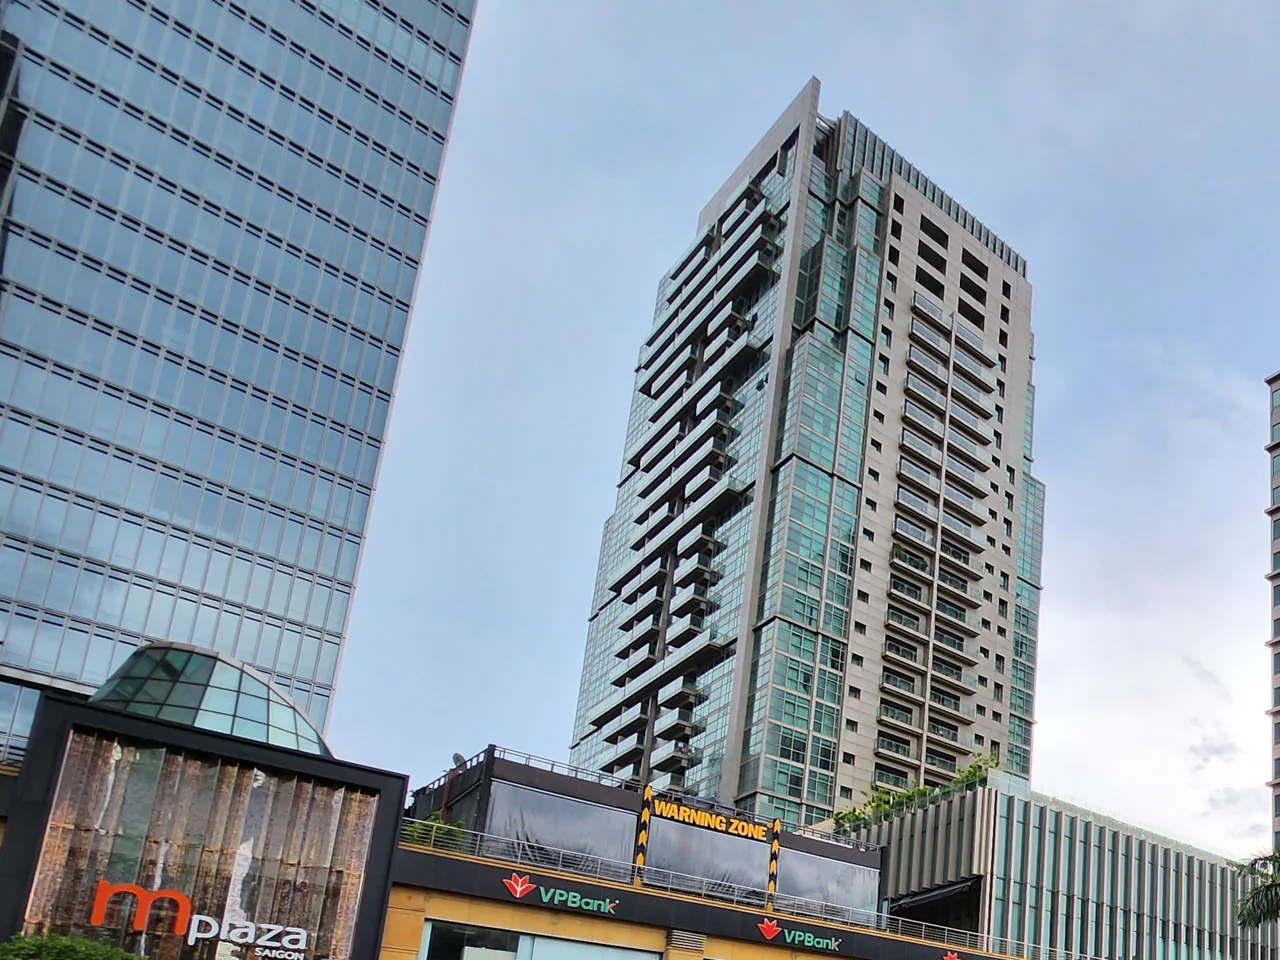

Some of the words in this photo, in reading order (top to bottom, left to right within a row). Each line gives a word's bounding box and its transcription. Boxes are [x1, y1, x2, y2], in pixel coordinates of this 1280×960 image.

[654, 799, 726, 831] WARNING
[728, 818, 767, 841] ZONE
[90, 879, 192, 936] m
[187, 914, 308, 949] plaza
[539, 886, 617, 915] VPBank
[783, 928, 840, 951] VPBank
